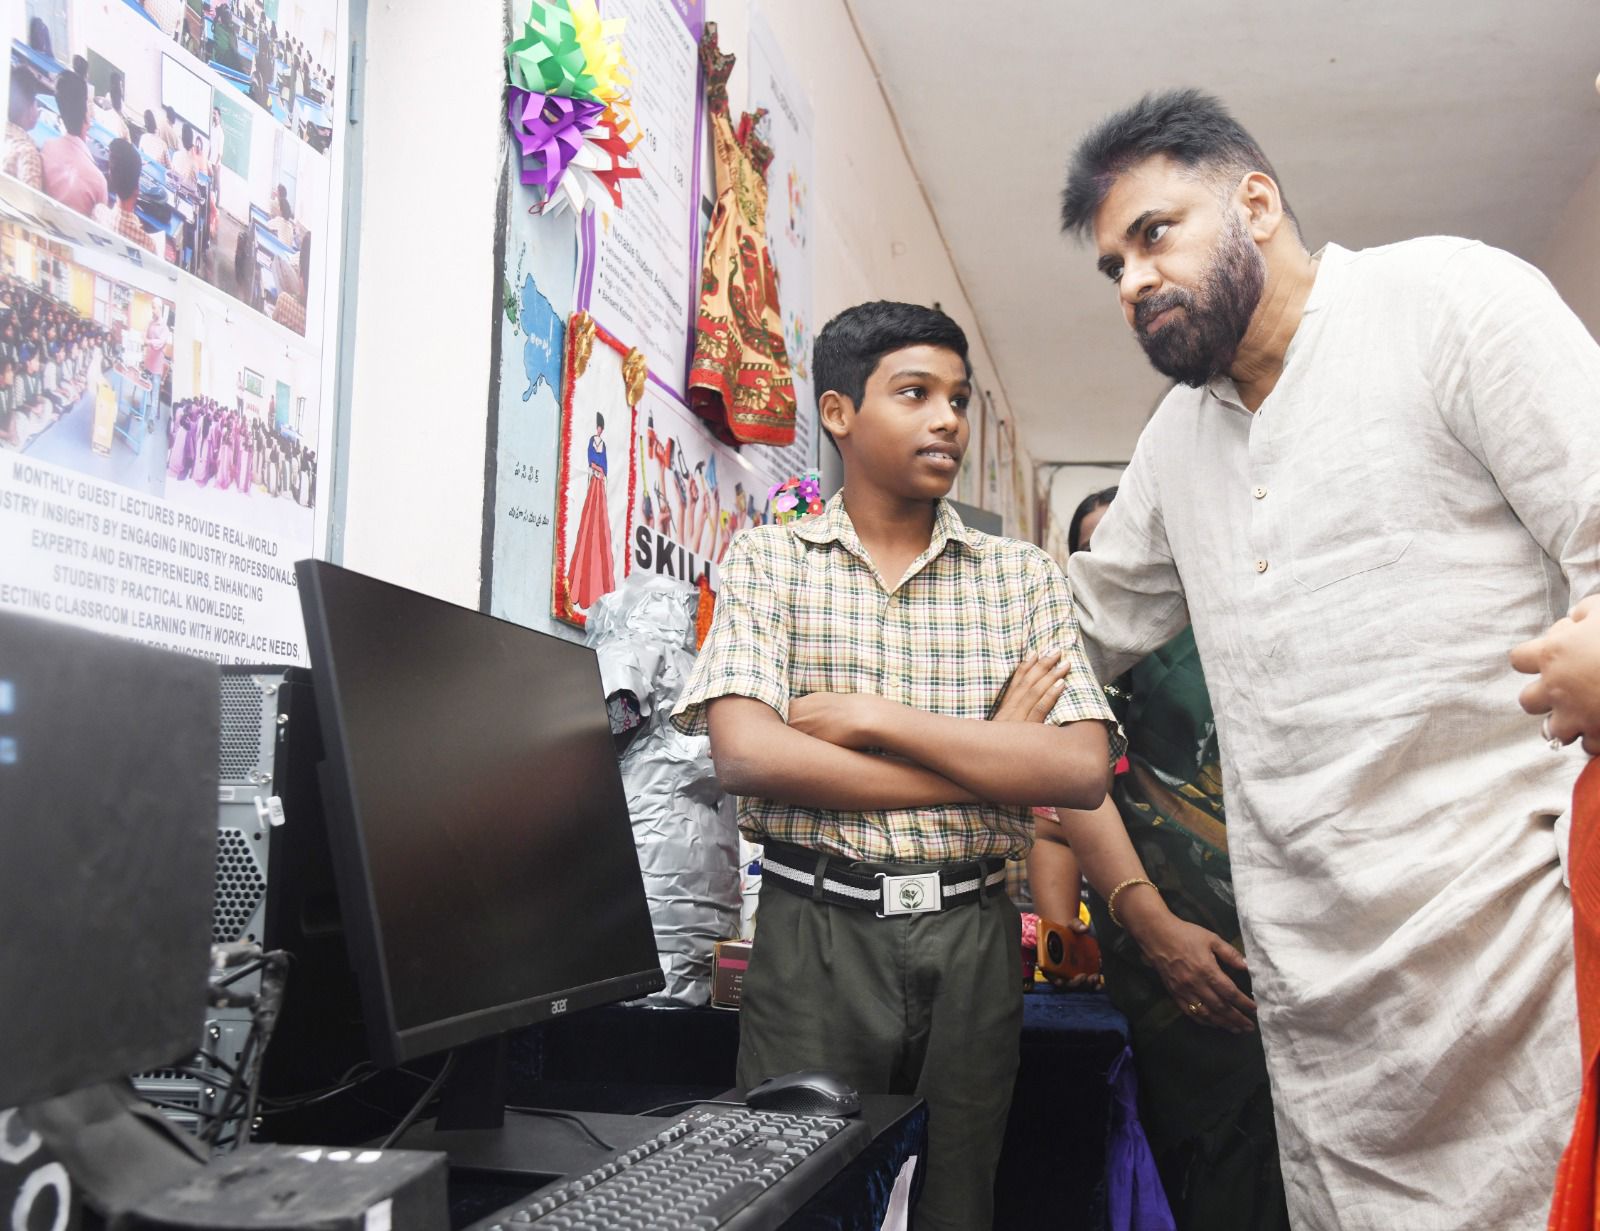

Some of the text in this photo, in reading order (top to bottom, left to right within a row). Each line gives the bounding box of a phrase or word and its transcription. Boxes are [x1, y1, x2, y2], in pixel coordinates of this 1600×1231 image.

[0, 489, 297, 587] STRY INSIGHTS BY ENGAGING INDUSTRY PROFESSIONALS
[12, 462, 278, 557] MONTHLY GUEST LECTURES PROVIDE REAL-WORLD
[31, 528, 88, 559] EXPERTS
[91, 544, 115, 566] AND
[214, 575, 263, 602] ENHANCING
[55, 595, 128, 624] CLASSROOM
[132, 612, 187, 636] LEARNING
[189, 622, 212, 641] WITH
[213, 626, 267, 653] WORKPLACE
[268, 639, 300, 661] NEEDS,
[121, 580, 183, 609] PRACTICAL
[186, 594, 245, 624] KNOWLEDGE,
[552, 998, 568, 1014] acer
